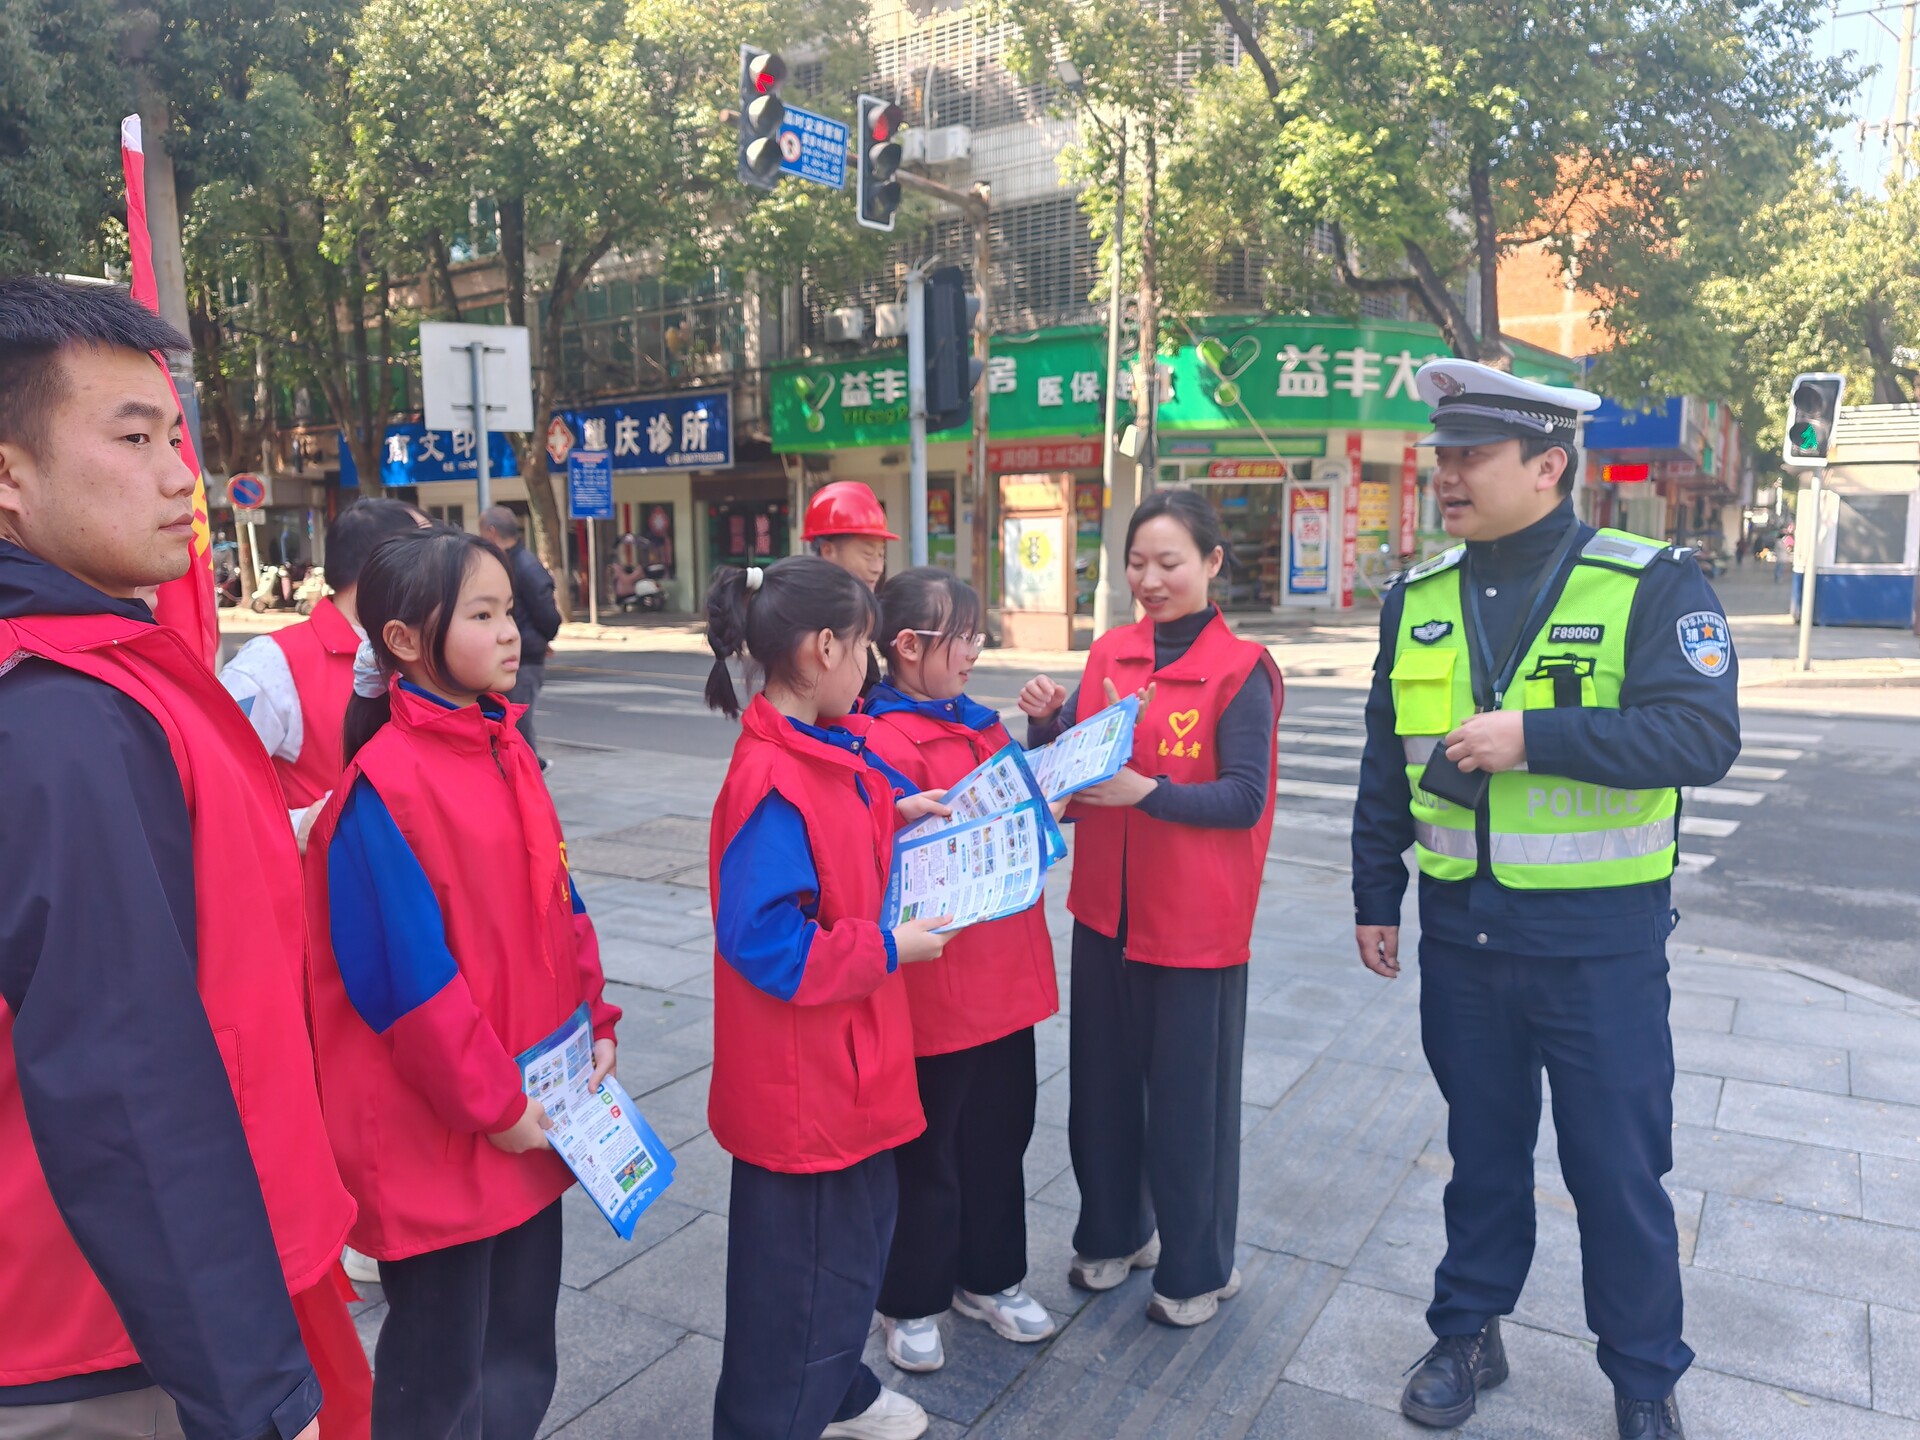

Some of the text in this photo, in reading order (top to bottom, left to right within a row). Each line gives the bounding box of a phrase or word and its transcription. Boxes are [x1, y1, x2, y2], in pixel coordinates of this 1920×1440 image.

[1276, 344, 1438, 401] 益丰大
[1551, 626, 1600, 641] F89060
[1157, 738, 1202, 760] 志愿者
[1528, 786, 1642, 818] POLICE
